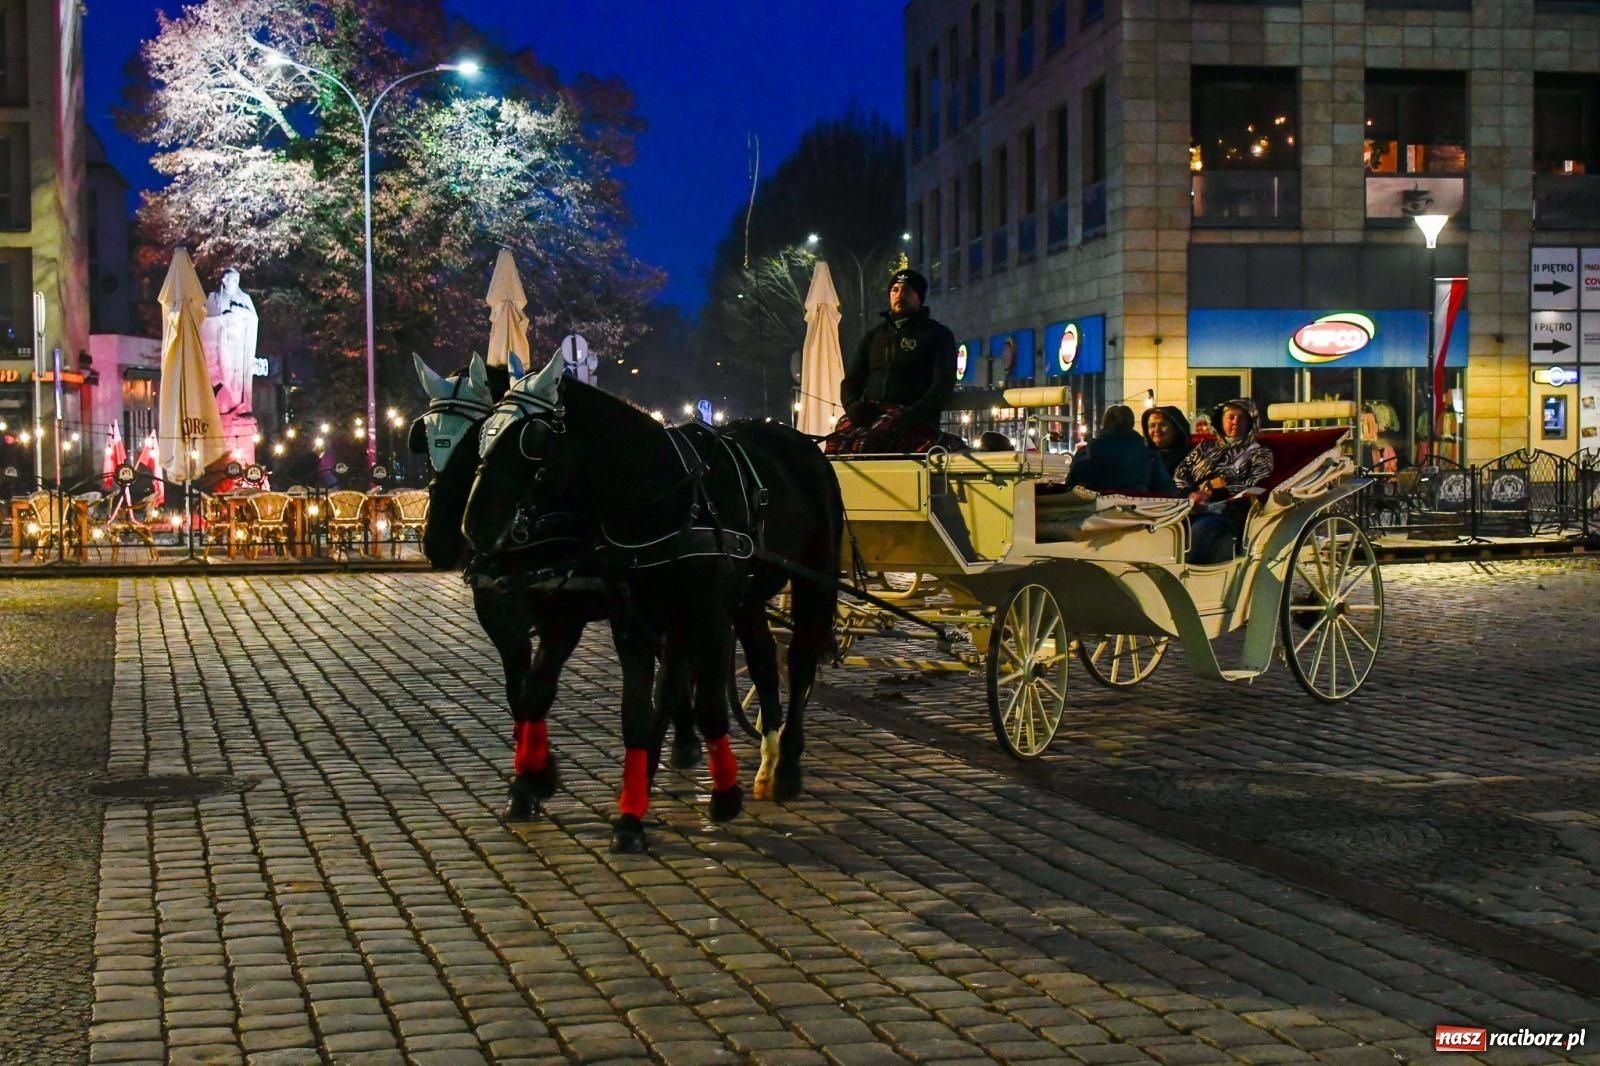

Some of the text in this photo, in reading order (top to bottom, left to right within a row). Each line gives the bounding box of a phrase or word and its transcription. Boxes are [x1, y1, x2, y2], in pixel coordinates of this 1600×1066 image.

[1533, 263, 1574, 274] II PIĘTRO
[1535, 322, 1572, 333] I PIĘTRO
